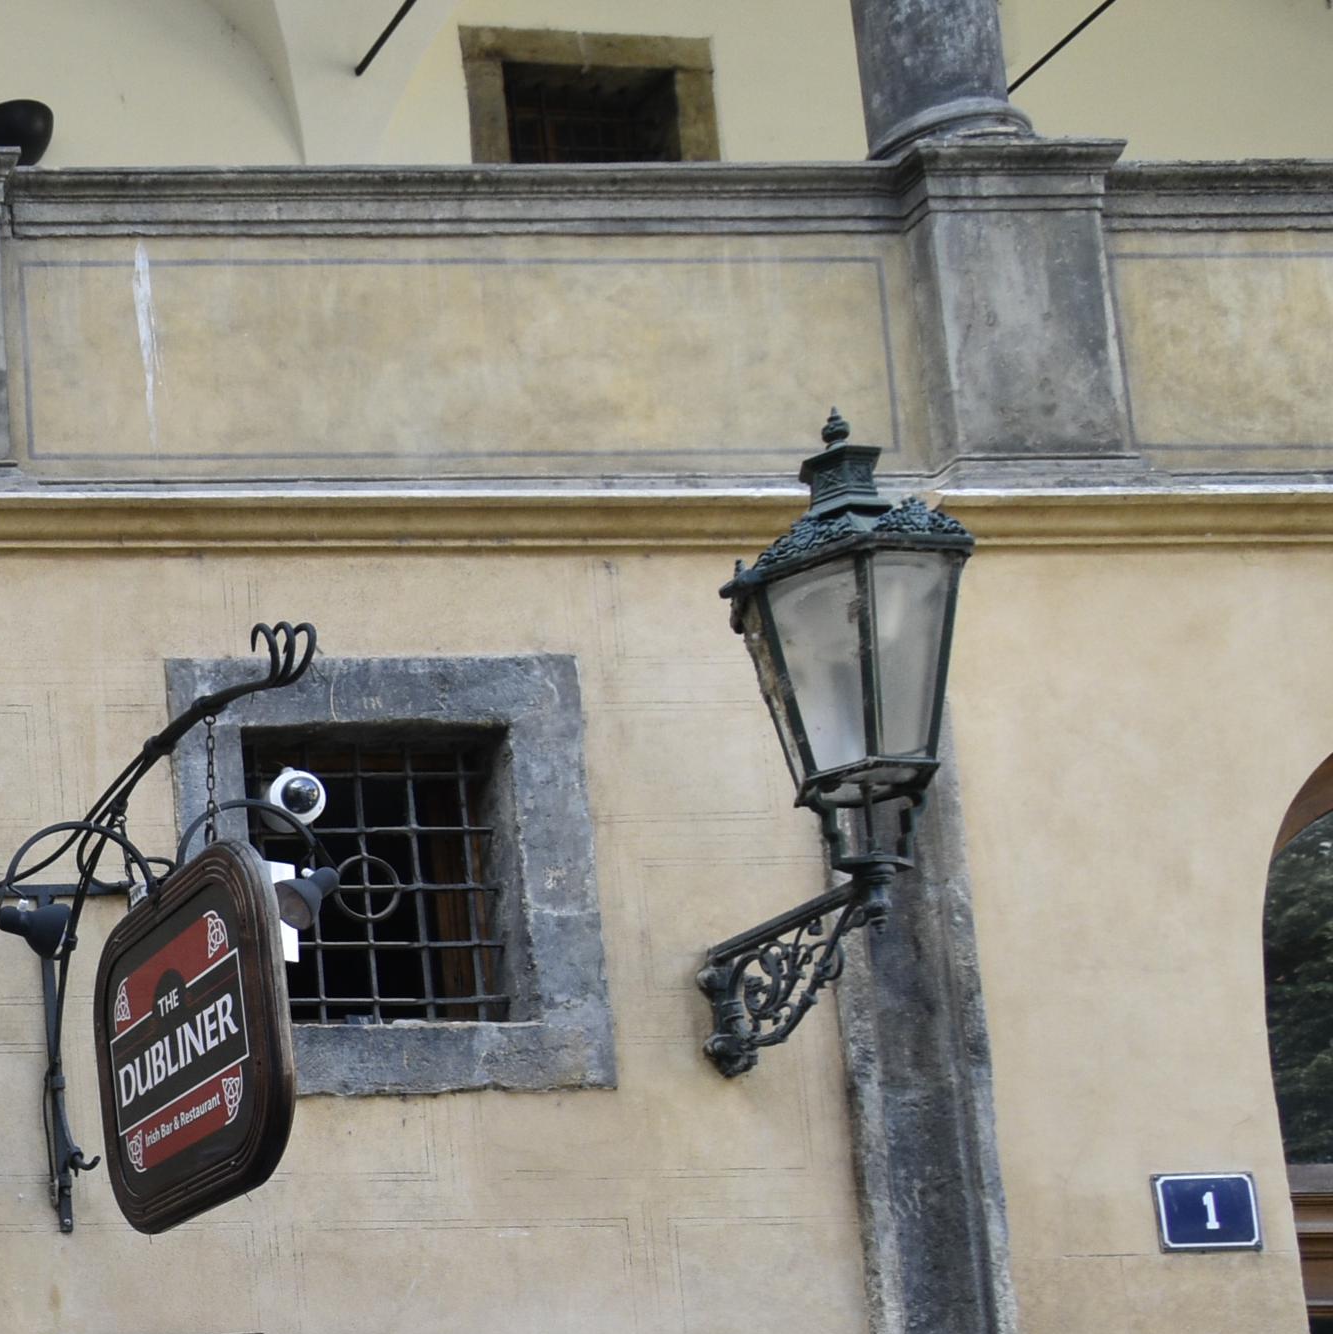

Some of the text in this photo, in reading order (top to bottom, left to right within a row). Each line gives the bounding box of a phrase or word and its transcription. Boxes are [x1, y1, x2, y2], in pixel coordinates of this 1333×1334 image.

[157, 988, 180, 1017] THE
[118, 992, 239, 1109] DUBLINER
[144, 1093, 221, 1149] Irish Bar & Restaurant
[1203, 1191, 1220, 1230] 1
